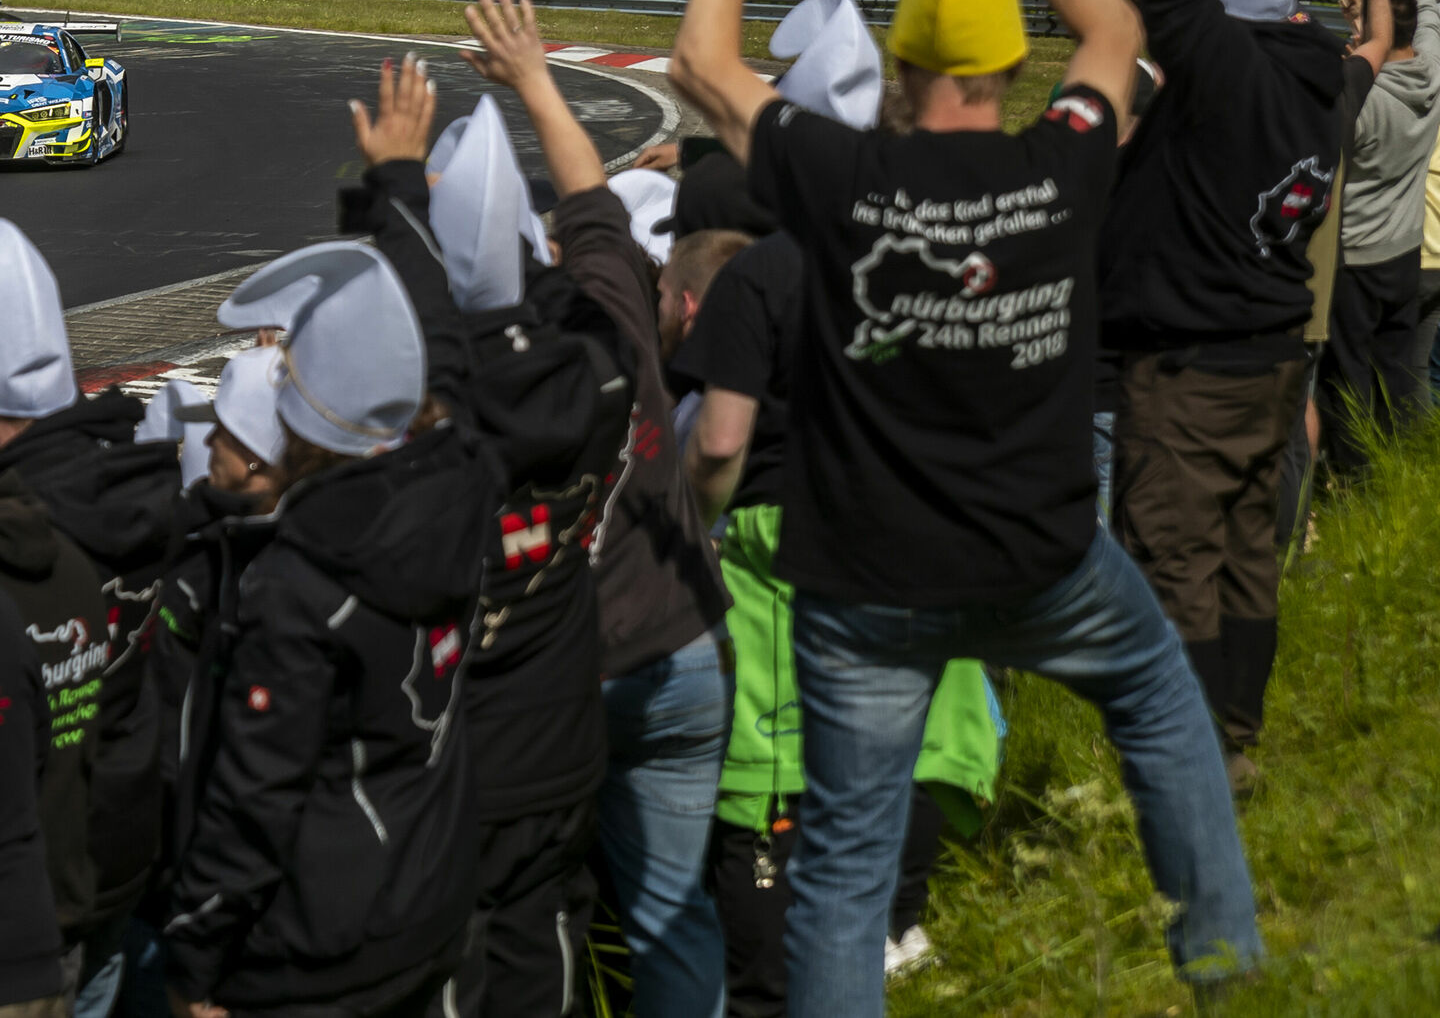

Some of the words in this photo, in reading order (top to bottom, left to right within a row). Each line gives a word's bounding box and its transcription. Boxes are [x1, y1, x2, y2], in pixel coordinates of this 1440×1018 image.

[8, 34, 51, 45] TURISMO
[974, 209, 1048, 246] gefallen
[890, 276, 1075, 323] nürburgring
[916, 322, 974, 349] 24h
[977, 307, 1071, 348] Rennen
[1010, 331, 1068, 370] 2018
